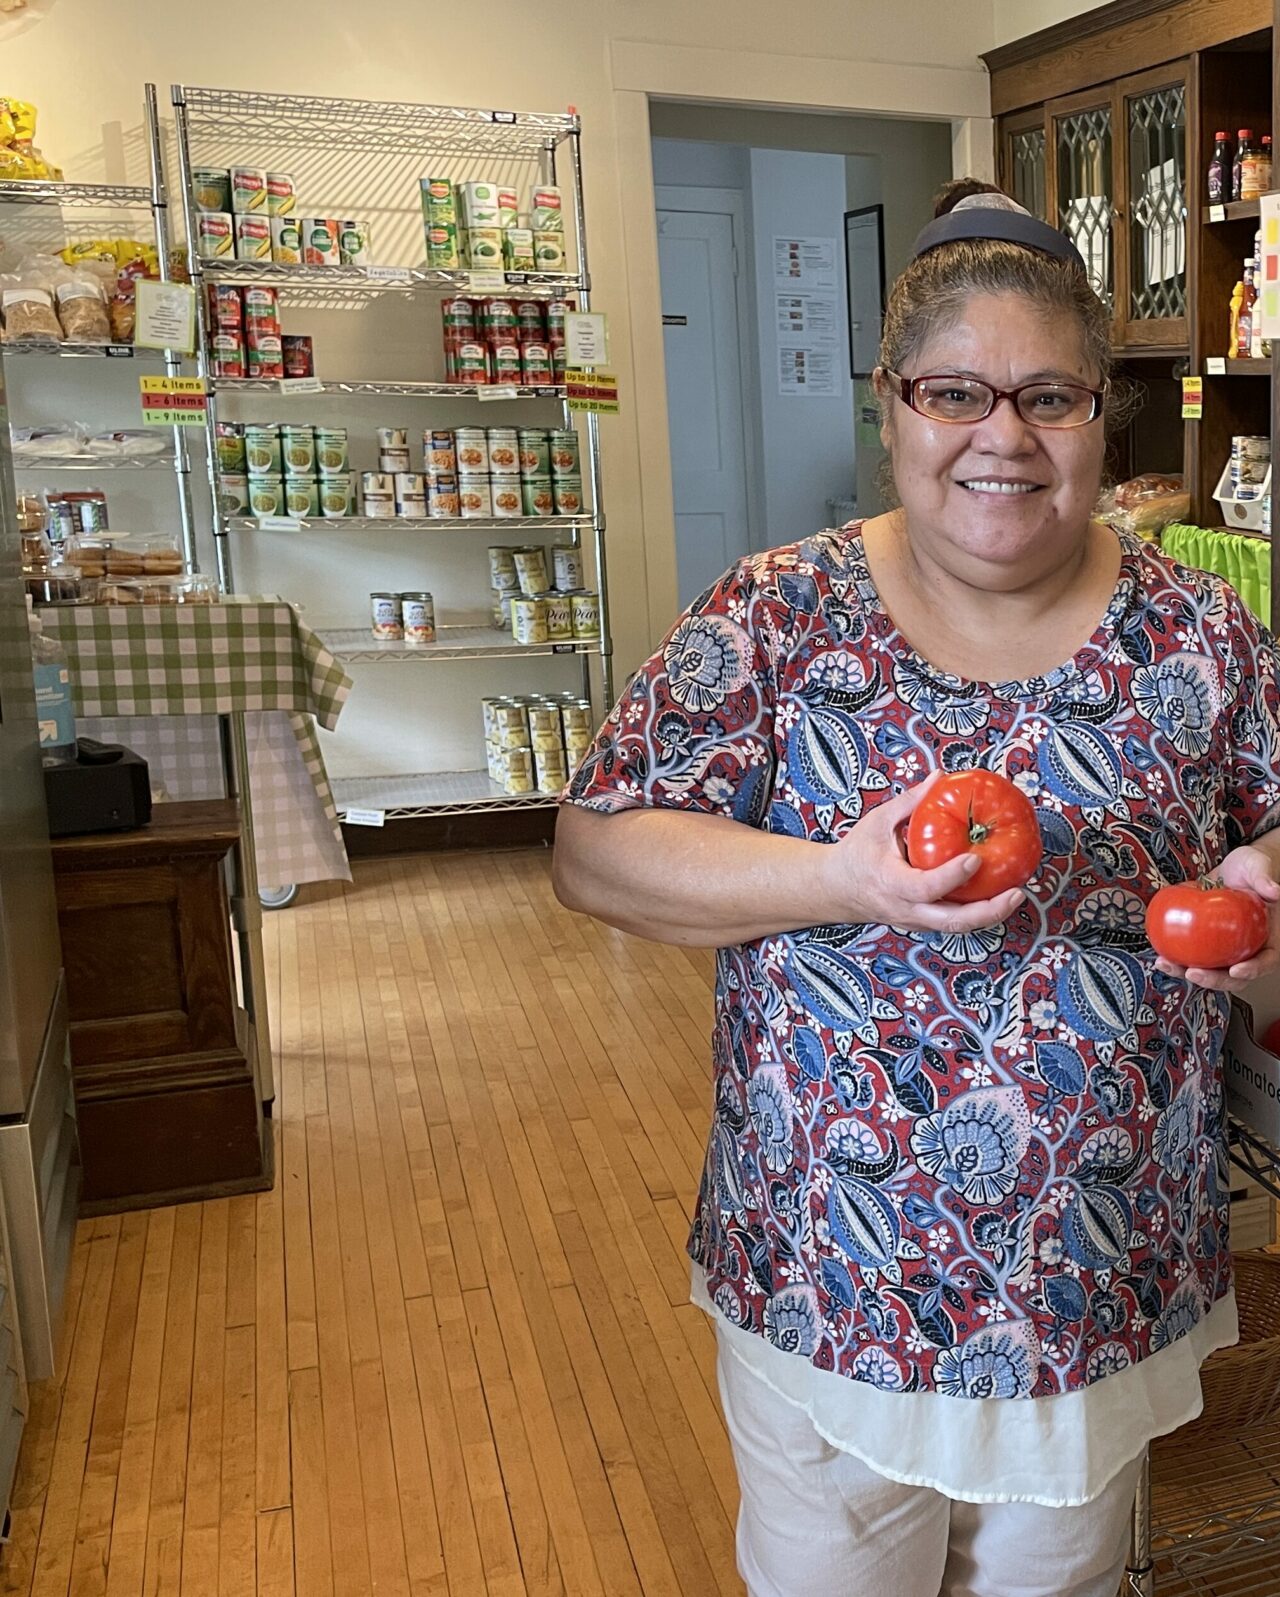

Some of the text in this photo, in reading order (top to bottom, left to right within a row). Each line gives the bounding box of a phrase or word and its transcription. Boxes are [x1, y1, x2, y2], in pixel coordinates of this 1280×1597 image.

[566, 374, 577, 384] Up
[577, 374, 586, 383] to
[143, 380, 148, 389] 1
[161, 380, 168, 389] 4
[170, 379, 201, 390] Items
[578, 388, 587, 396] to
[146, 396, 151, 405] 1
[173, 395, 204, 406] Items
[569, 400, 580, 411] Up
[580, 401, 588, 409] to
[599, 402, 618, 411] Items
[146, 412, 151, 422] 1
[163, 412, 170, 422] 9
[173, 412, 204, 422] Items
